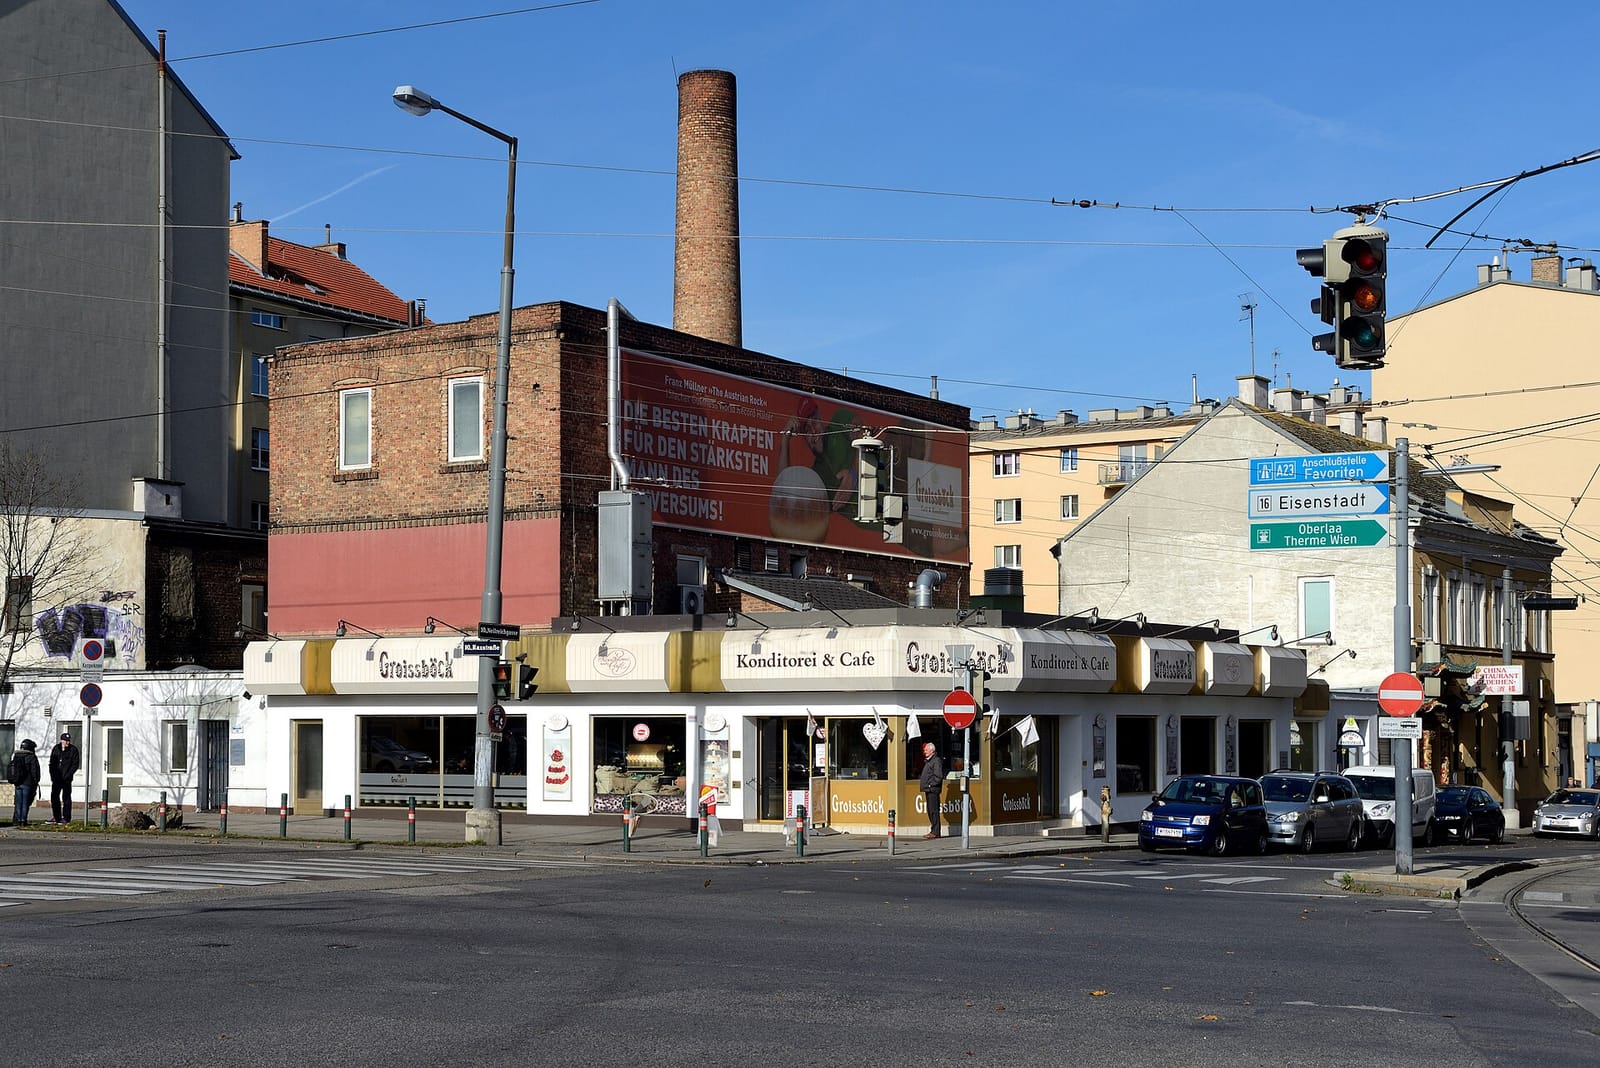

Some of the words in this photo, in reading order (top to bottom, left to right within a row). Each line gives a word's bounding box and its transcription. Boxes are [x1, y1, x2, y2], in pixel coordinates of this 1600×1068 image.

[664, 375, 682, 387] Franz
[683, 379, 707, 394] Müllner
[724, 388, 748, 403] Austrian
[623, 400, 648, 425] DIE
[652, 405, 708, 438] BESTEN
[712, 418, 774, 450] KRAPFEN
[623, 425, 653, 455] FÜR
[657, 435, 687, 461] DEN
[690, 440, 769, 476] STÄRKSTEN
[1276, 464, 1294, 477] A23
[1302, 455, 1367, 468] Anschlußstelle
[624, 456, 669, 484] MANN
[672, 464, 700, 489] DES
[1304, 467, 1364, 480] Favoriten
[634, 487, 724, 521] VERSUMS!
[1259, 497, 1269, 510] 16
[1279, 492, 1366, 510] Eisenstadt
[1298, 524, 1342, 535] Oberlaa
[1284, 535, 1326, 546] Therme
[1330, 534, 1357, 545] Wien
[380, 651, 454, 679] Groissböck
[737, 652, 817, 668] Konditorei
[822, 653, 835, 667] &
[840, 651, 875, 667] Cafe
[1031, 654, 1078, 670] Konditorei
[1081, 657, 1088, 670] &
[1090, 657, 1109, 671] Cafe
[1154, 650, 1192, 680] Groissböck
[832, 794, 885, 814] Groissböck
[1002, 792, 1031, 812] Groissböck
